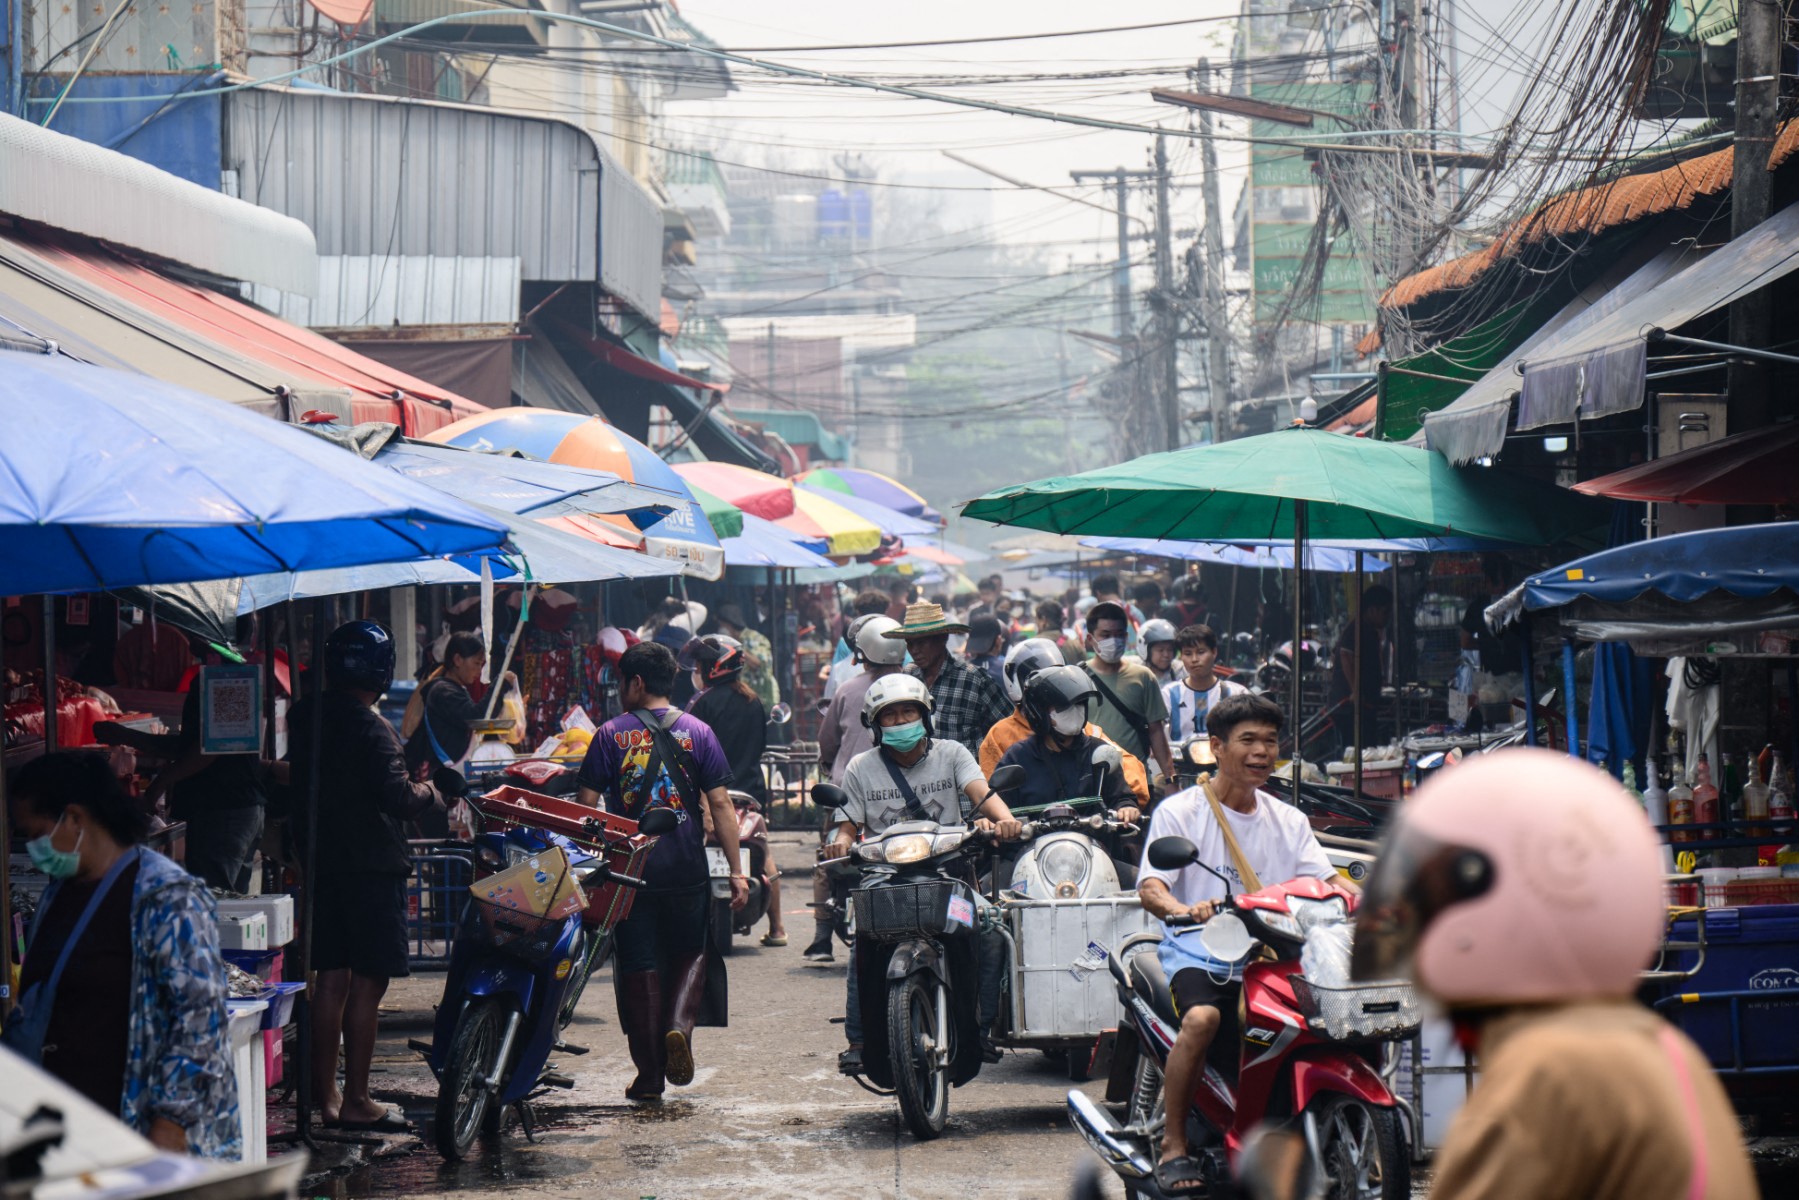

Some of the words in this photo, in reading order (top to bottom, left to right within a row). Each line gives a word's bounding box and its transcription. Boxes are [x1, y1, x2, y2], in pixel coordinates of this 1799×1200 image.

[664, 509, 696, 527] RIVE
[866, 784, 918, 802] LEGENDY
[921, 778, 953, 796] RIDERS
